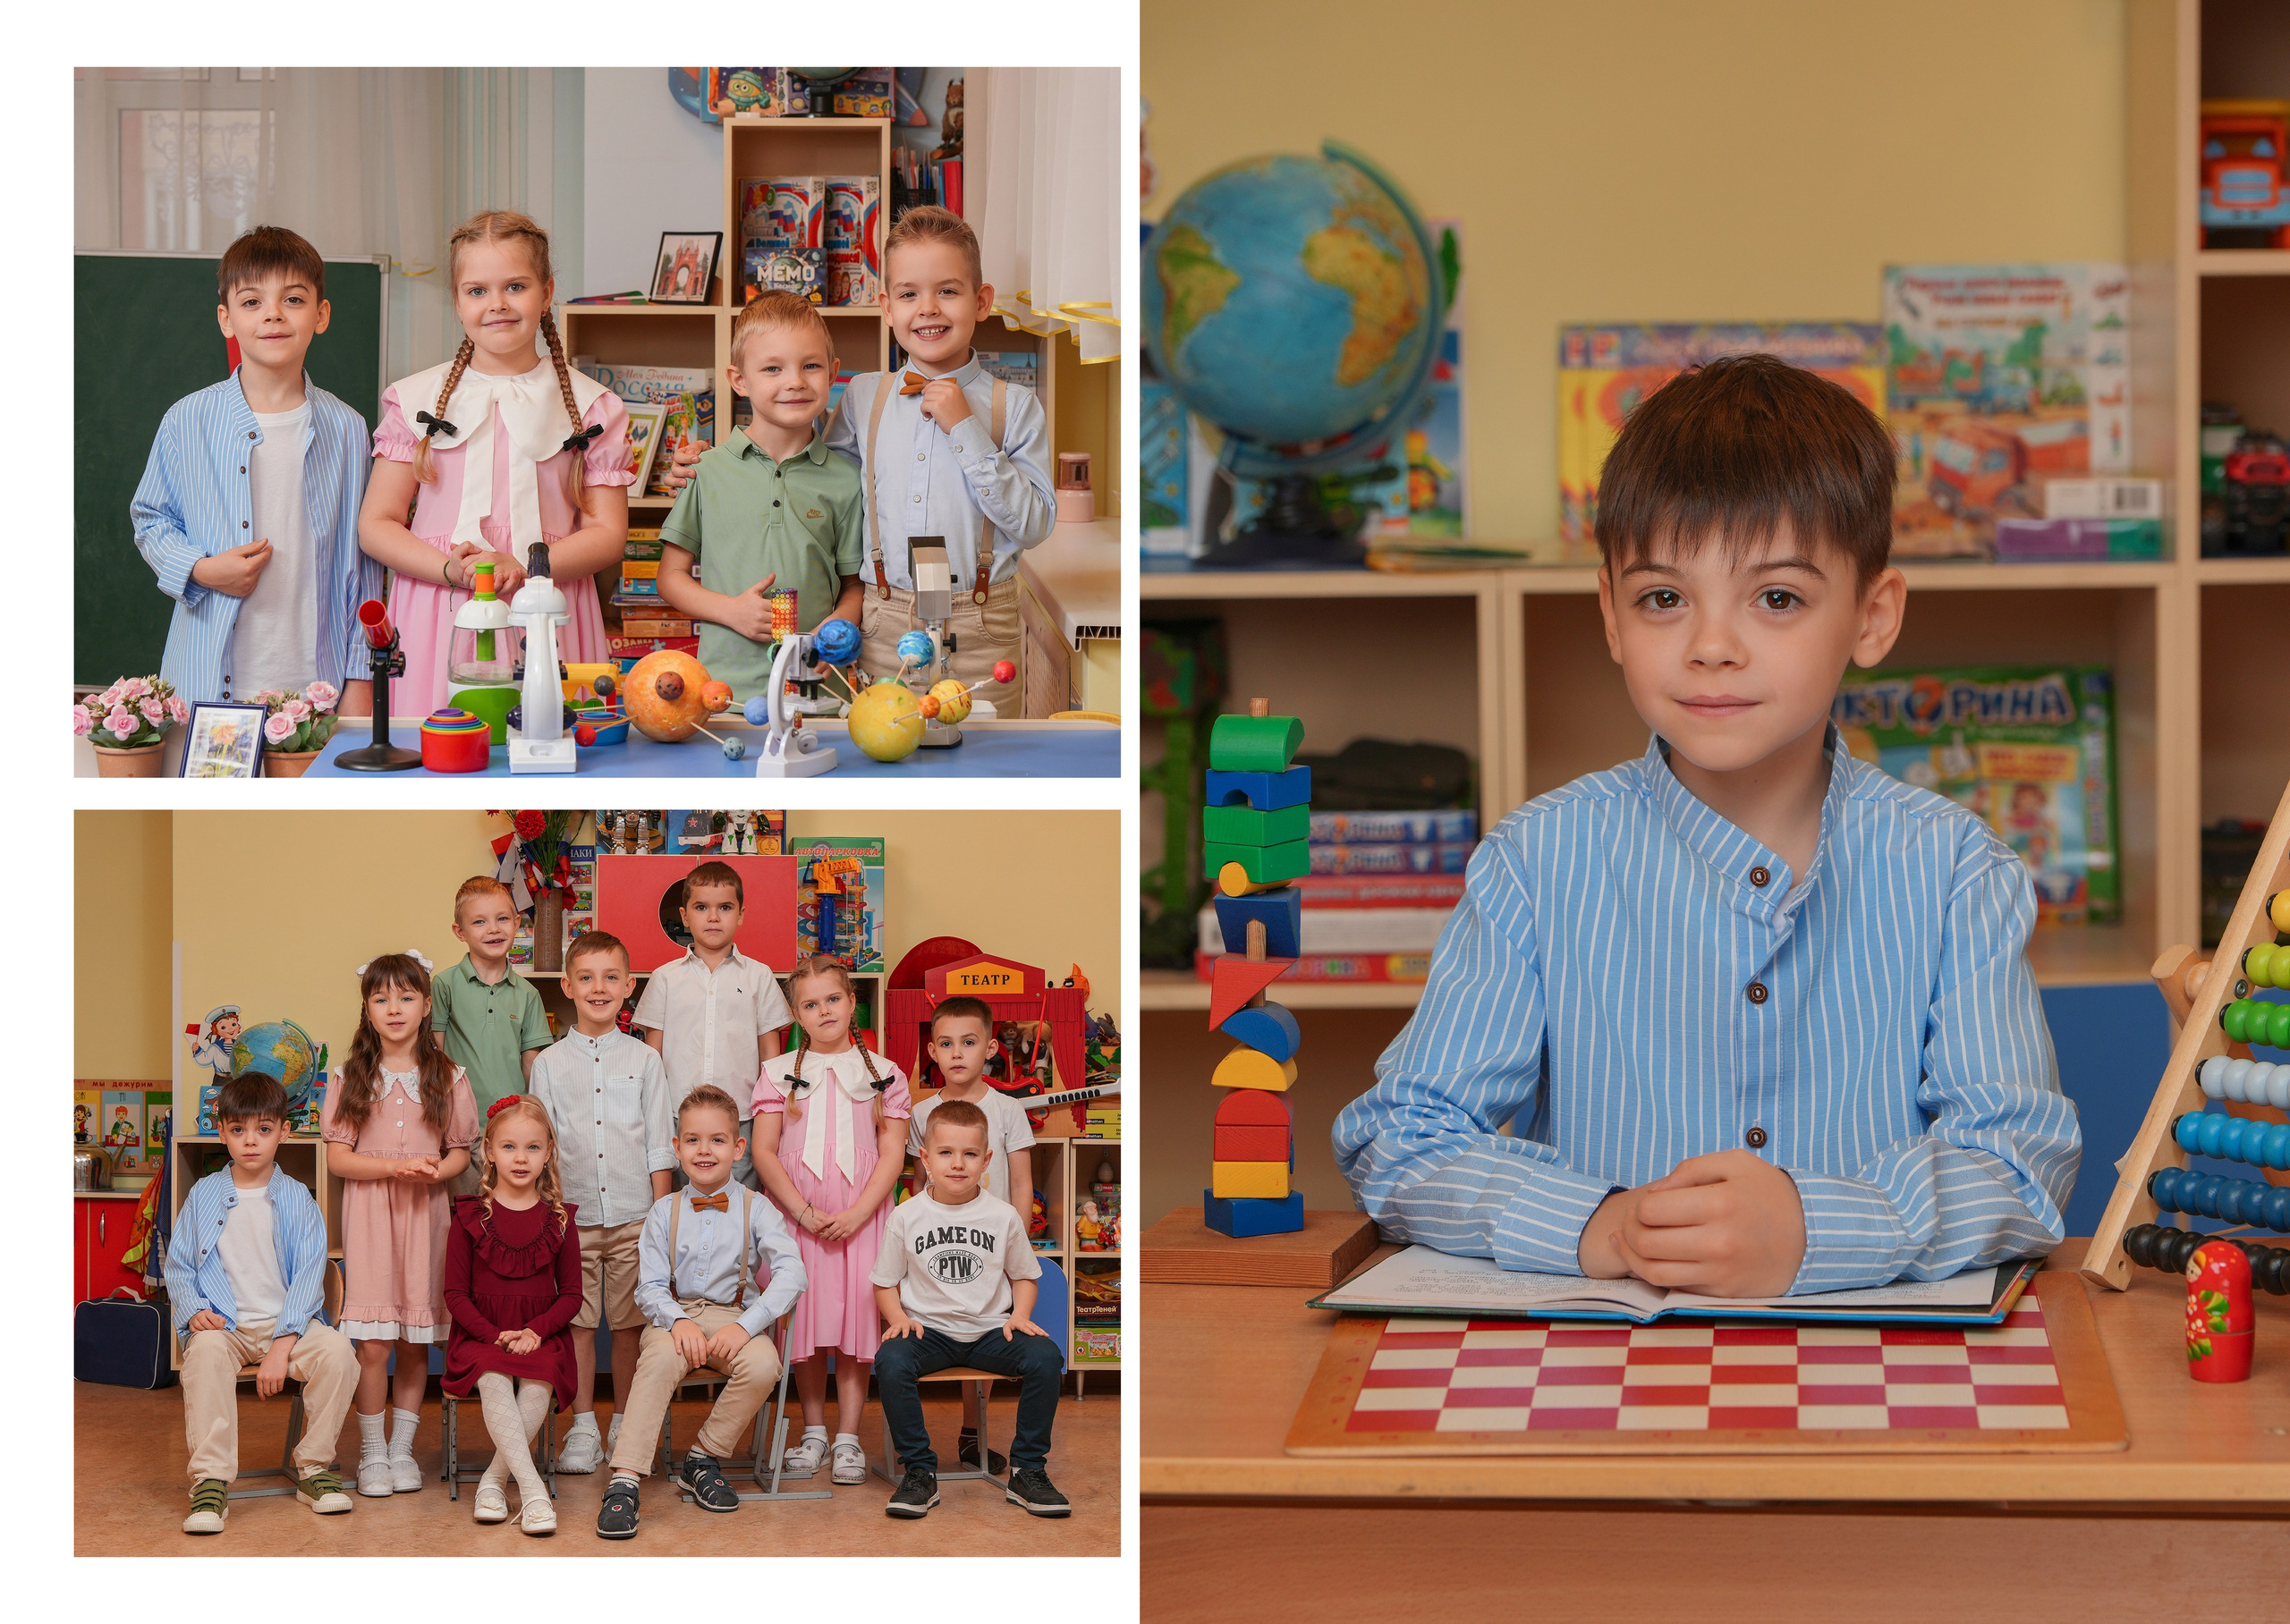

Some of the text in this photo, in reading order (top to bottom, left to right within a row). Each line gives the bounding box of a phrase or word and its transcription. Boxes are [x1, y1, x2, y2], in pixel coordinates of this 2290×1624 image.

[757, 266, 816, 282] МЕМО
[616, 368, 684, 382] Моя Родина
[1830, 677, 2069, 728] КТОРИНА
[795, 847, 878, 856] АВТОПАРКОВКА
[961, 974, 1010, 985] ТЕАТР
[113, 1081, 153, 1089] дежурим
[915, 1226, 995, 1255] GAME ON
[939, 1256, 972, 1278] PTW
